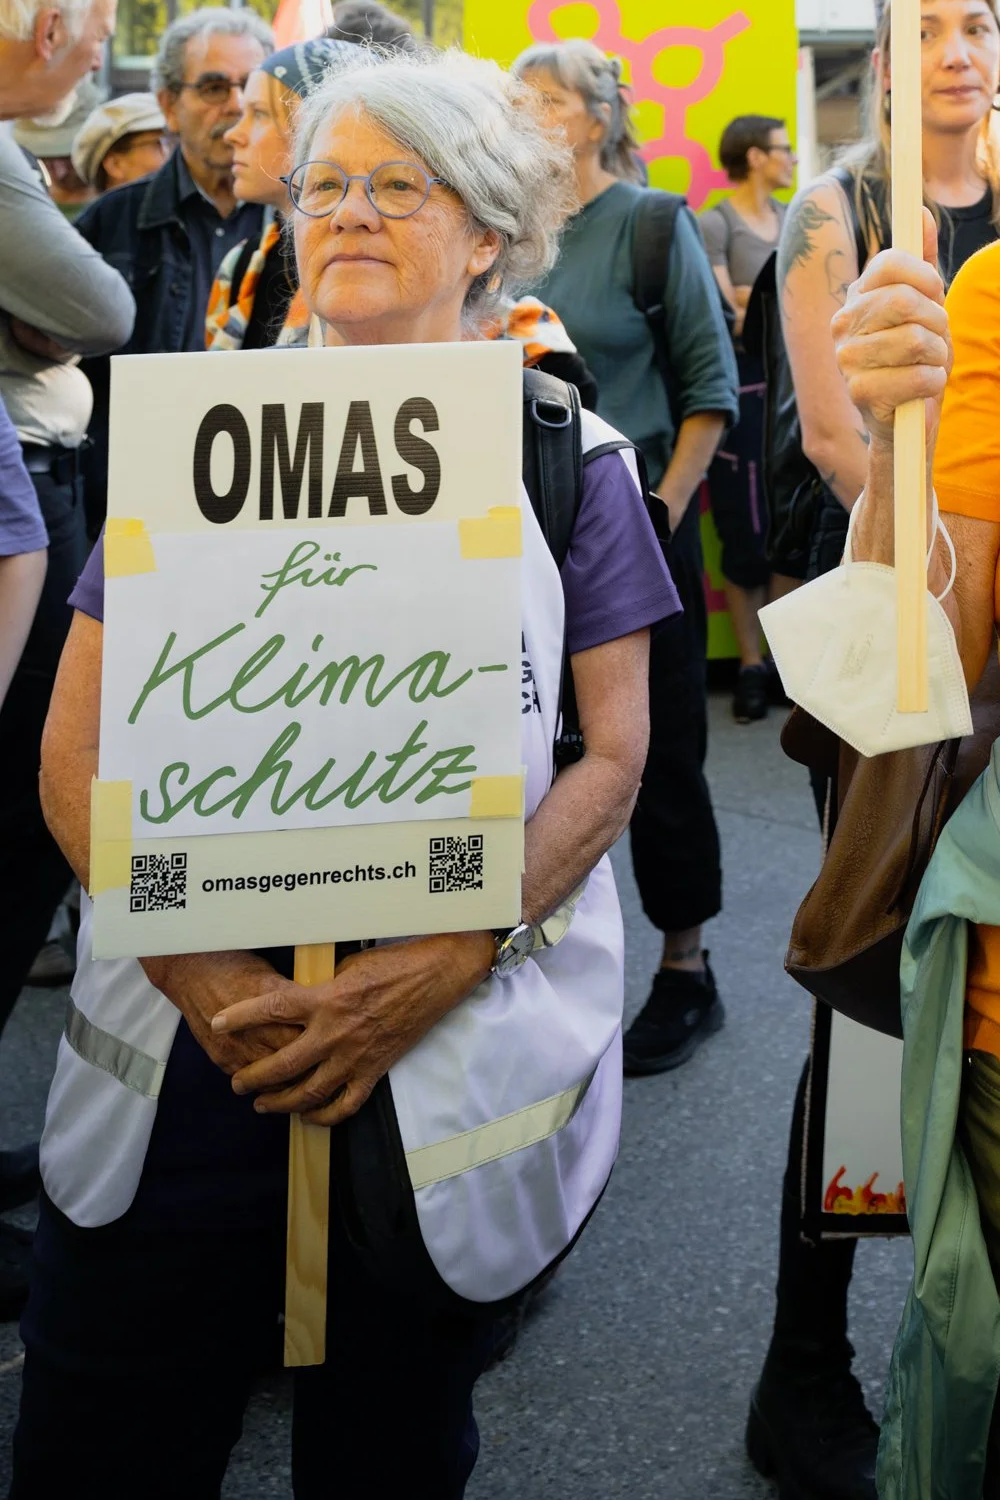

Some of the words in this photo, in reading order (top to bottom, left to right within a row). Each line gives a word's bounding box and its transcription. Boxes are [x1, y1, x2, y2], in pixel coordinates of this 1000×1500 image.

[192, 396, 441, 524] OMAS
[254, 540, 378, 618] für
[127, 622, 509, 726] Klima-
[139, 720, 477, 825] schutz
[201, 860, 417, 893] omasgegenrechts.ch
